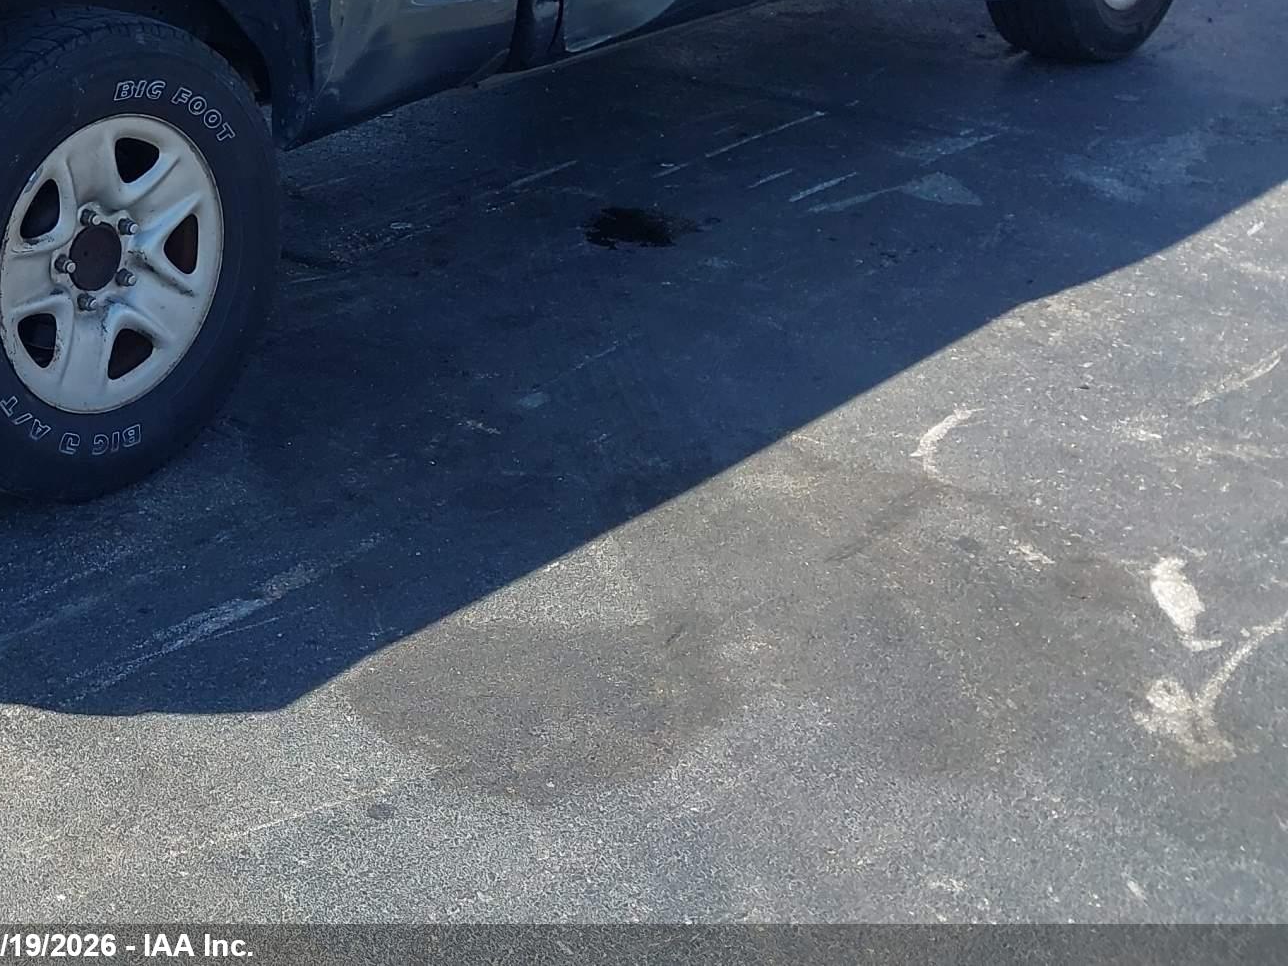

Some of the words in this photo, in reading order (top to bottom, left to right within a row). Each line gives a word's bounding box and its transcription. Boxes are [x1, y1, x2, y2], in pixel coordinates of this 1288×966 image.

[113, 80, 166, 101] BIG
[171, 86, 236, 141] FOOT
[0, 395, 52, 441] A/T
[91, 424, 142, 455] BIG
